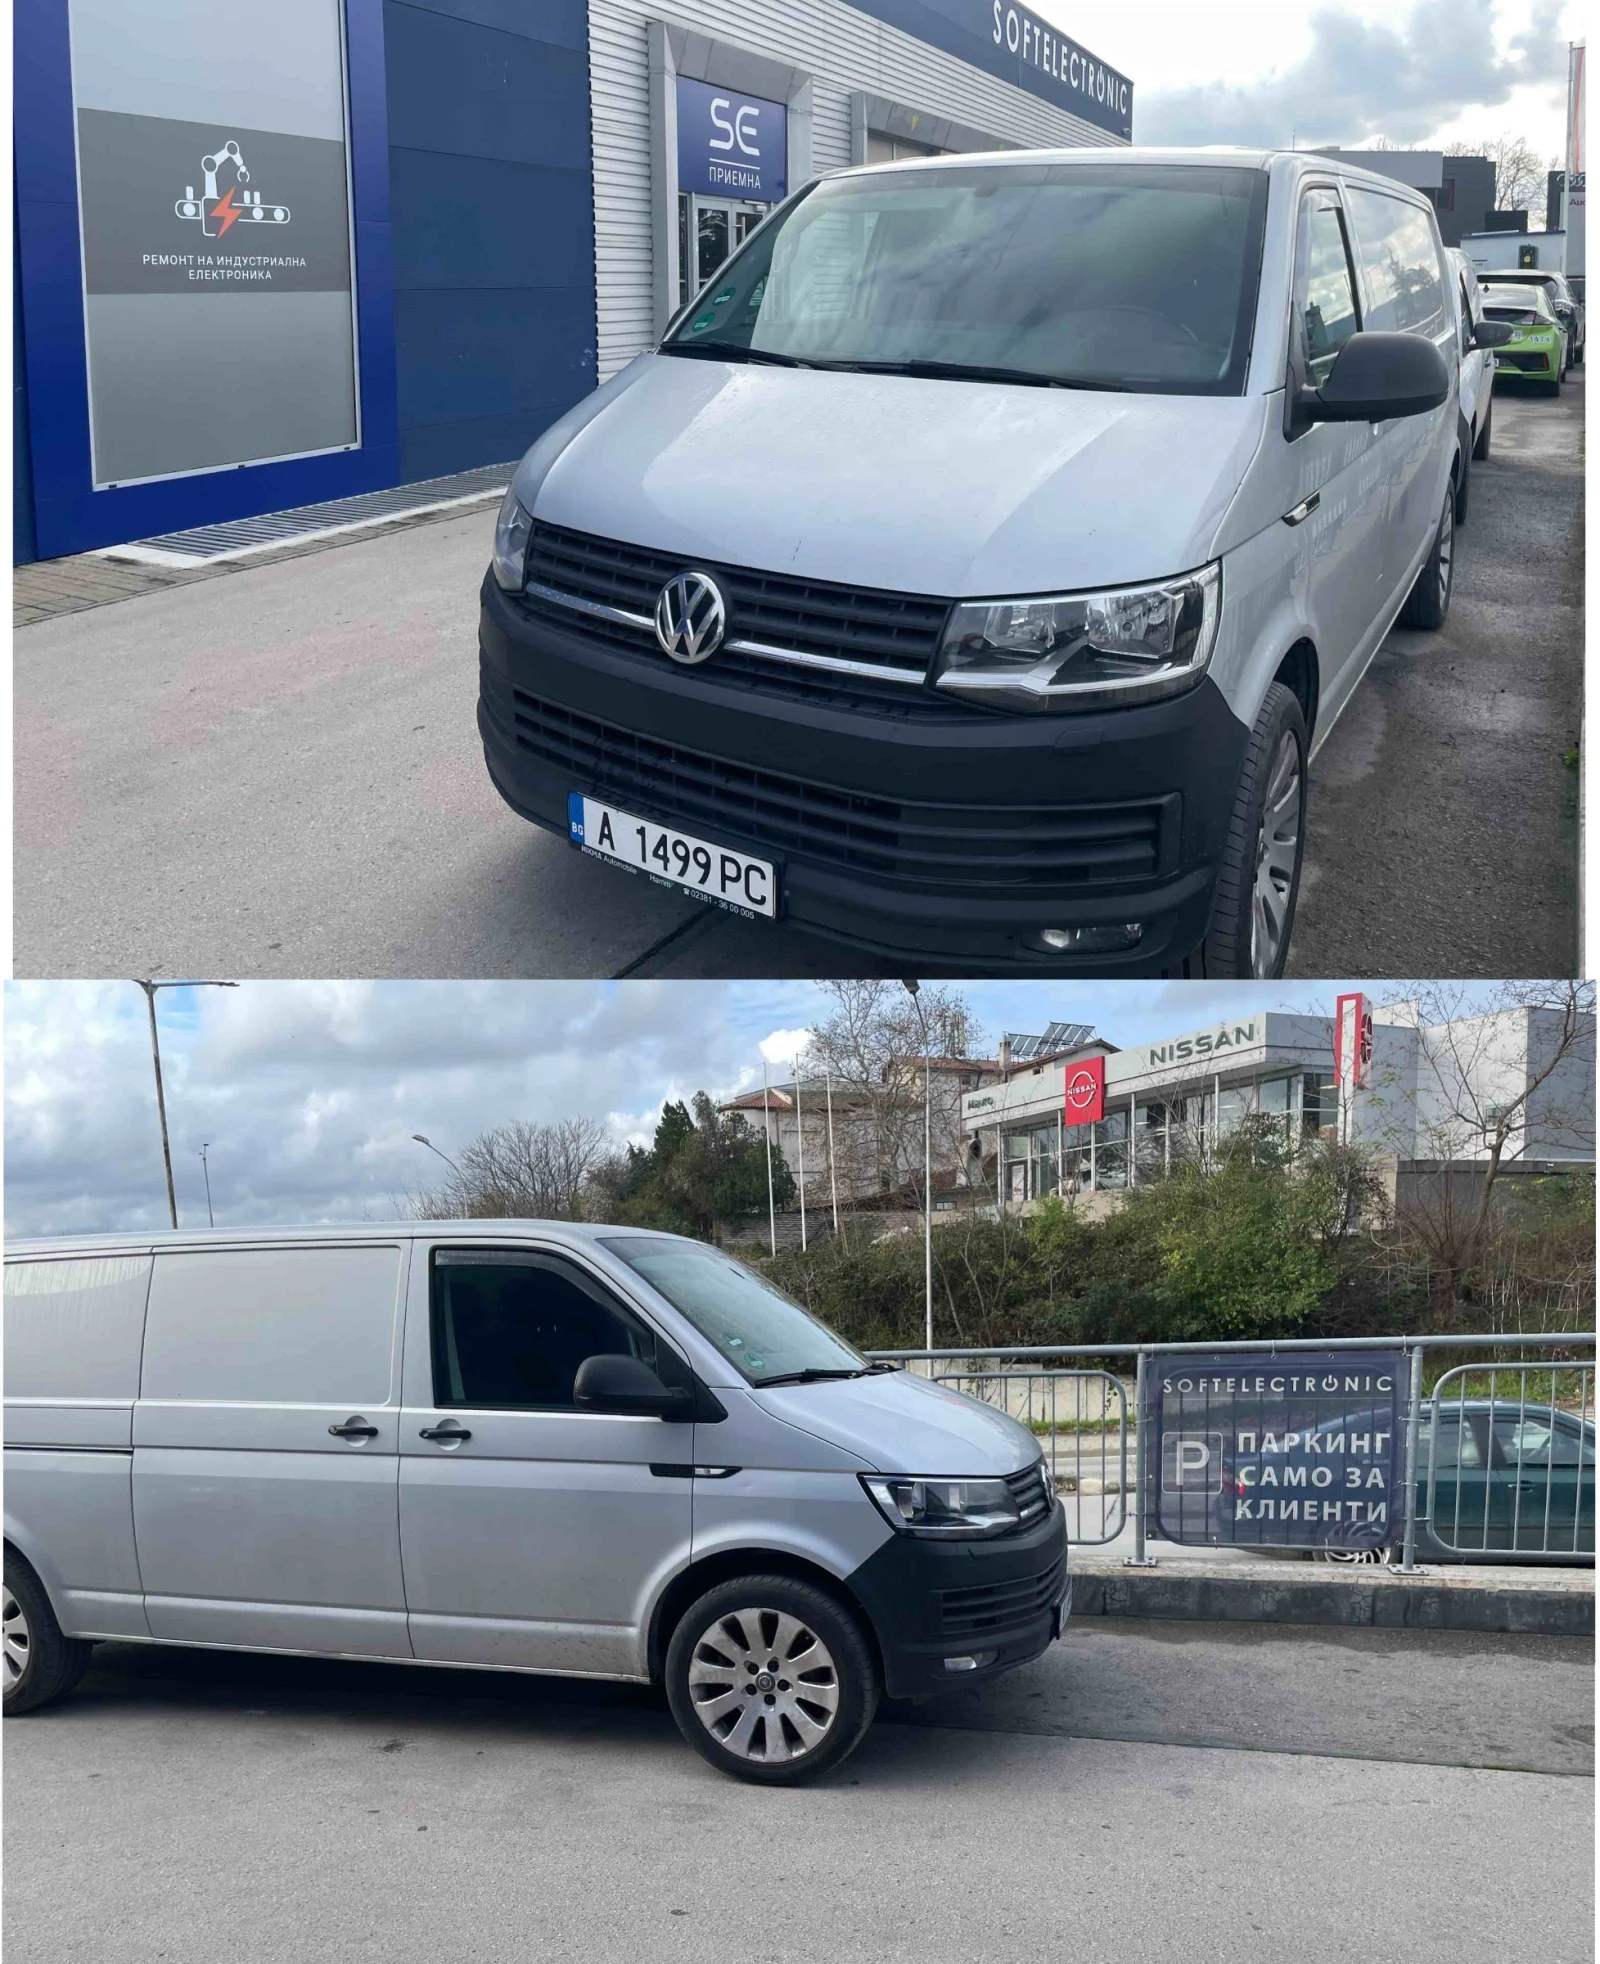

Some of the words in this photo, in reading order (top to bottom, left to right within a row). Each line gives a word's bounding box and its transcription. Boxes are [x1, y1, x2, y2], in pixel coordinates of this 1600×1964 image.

[993, 0, 1127, 115] SOFTELECTRONIC
[709, 166, 761, 189] ПРИЕМНА
[142, 254, 195, 266] РЕМОНТ
[197, 255, 214, 266] НА
[216, 255, 307, 268] ИНДУСТРИАЛНА
[188, 269, 272, 280] ЕЛЕКТРОНИКА
[571, 821, 584, 836] BG
[636, 825, 712, 885] 1499
[690, 889, 713, 904] 02381
[1150, 1024, 1254, 1066] NISSAN
[1067, 1083, 1098, 1097] NISSAN
[1163, 1374, 1393, 1394] SOFTELECTRONIC
[1238, 1432, 1391, 1455] ПАРКИНГ
[1240, 1465, 1334, 1489] САМО
[1346, 1466, 1386, 1489] ЗА
[1235, 1498, 1388, 1523] КЛИЕНТИ
